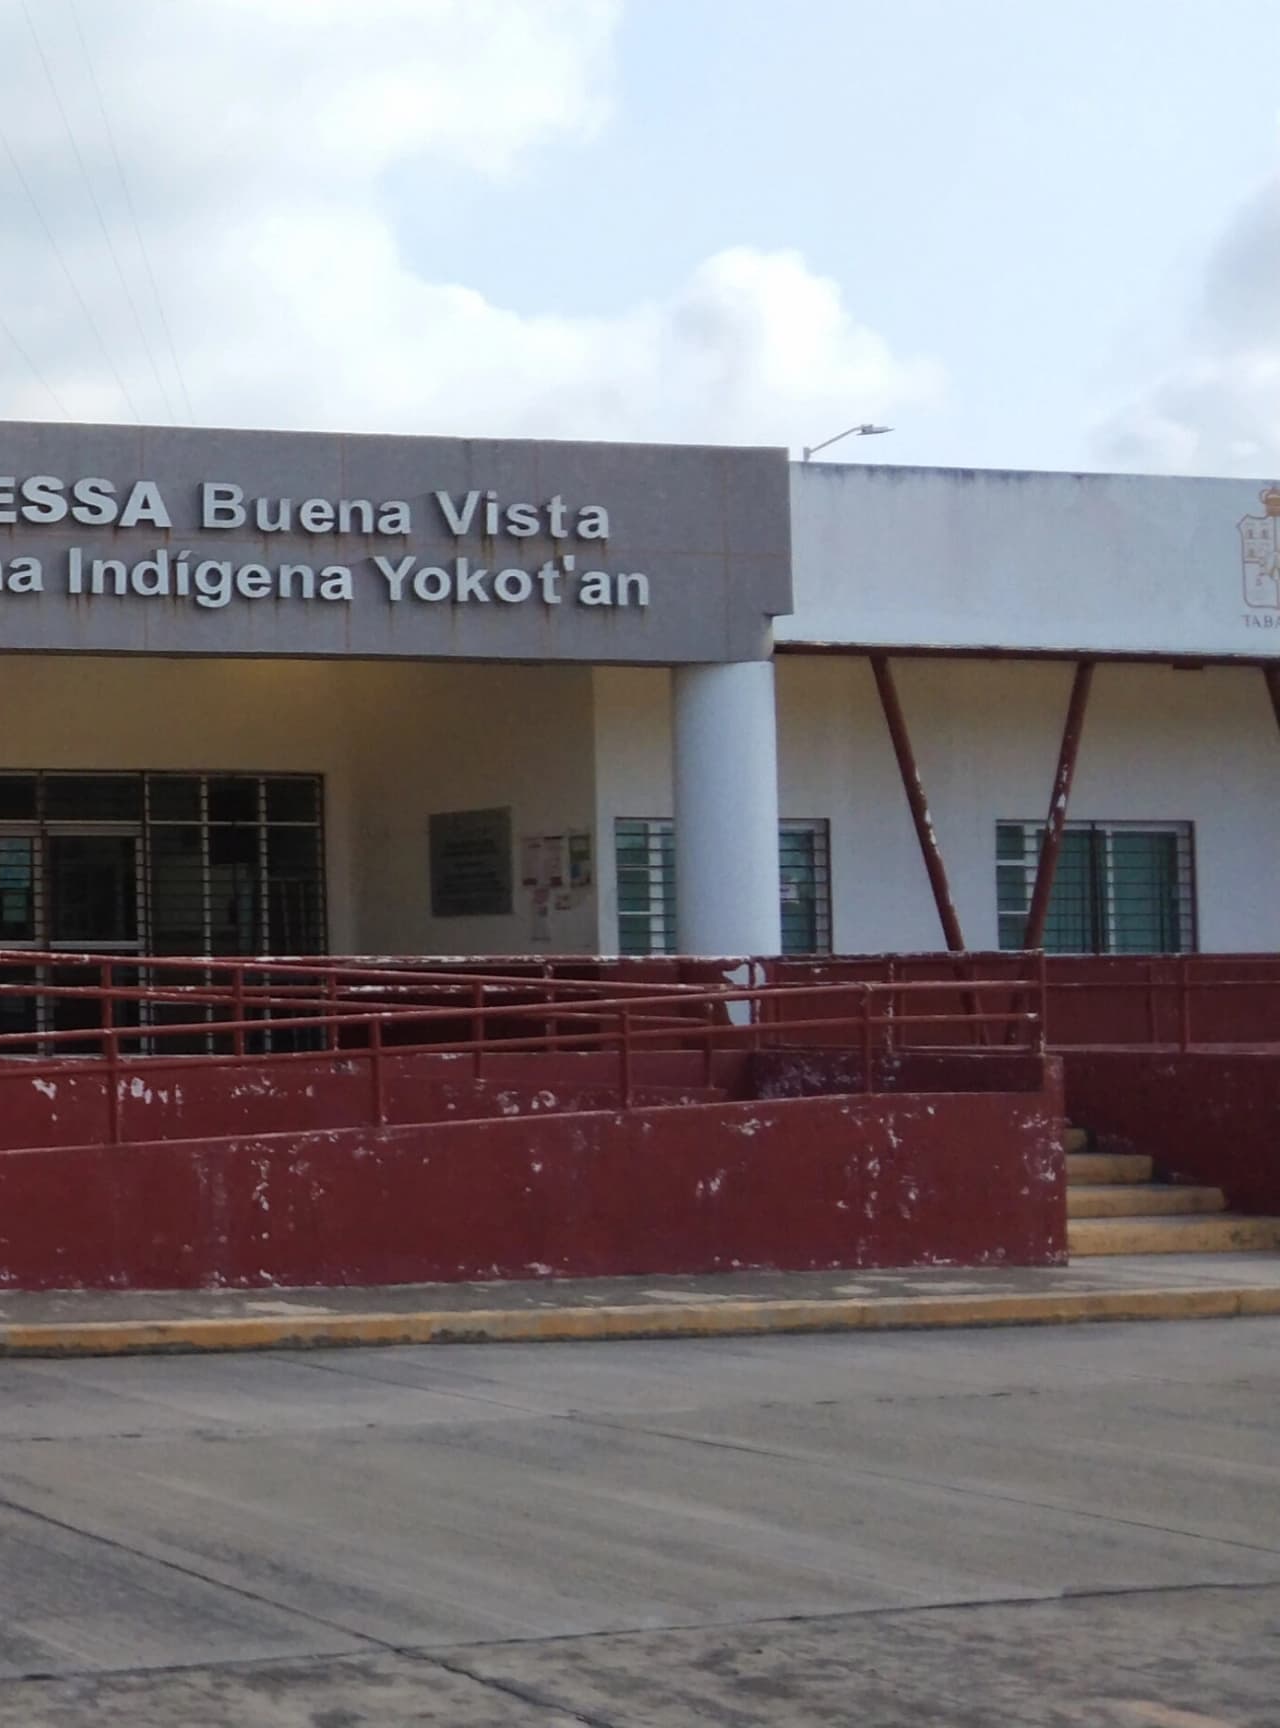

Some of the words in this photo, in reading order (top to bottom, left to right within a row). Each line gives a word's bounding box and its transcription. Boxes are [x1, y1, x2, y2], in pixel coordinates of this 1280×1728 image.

[199, 481, 412, 536] Buena
[436, 489, 612, 540] Vista
[66, 546, 354, 609] Indígena
[369, 553, 651, 607] Yokot'an
